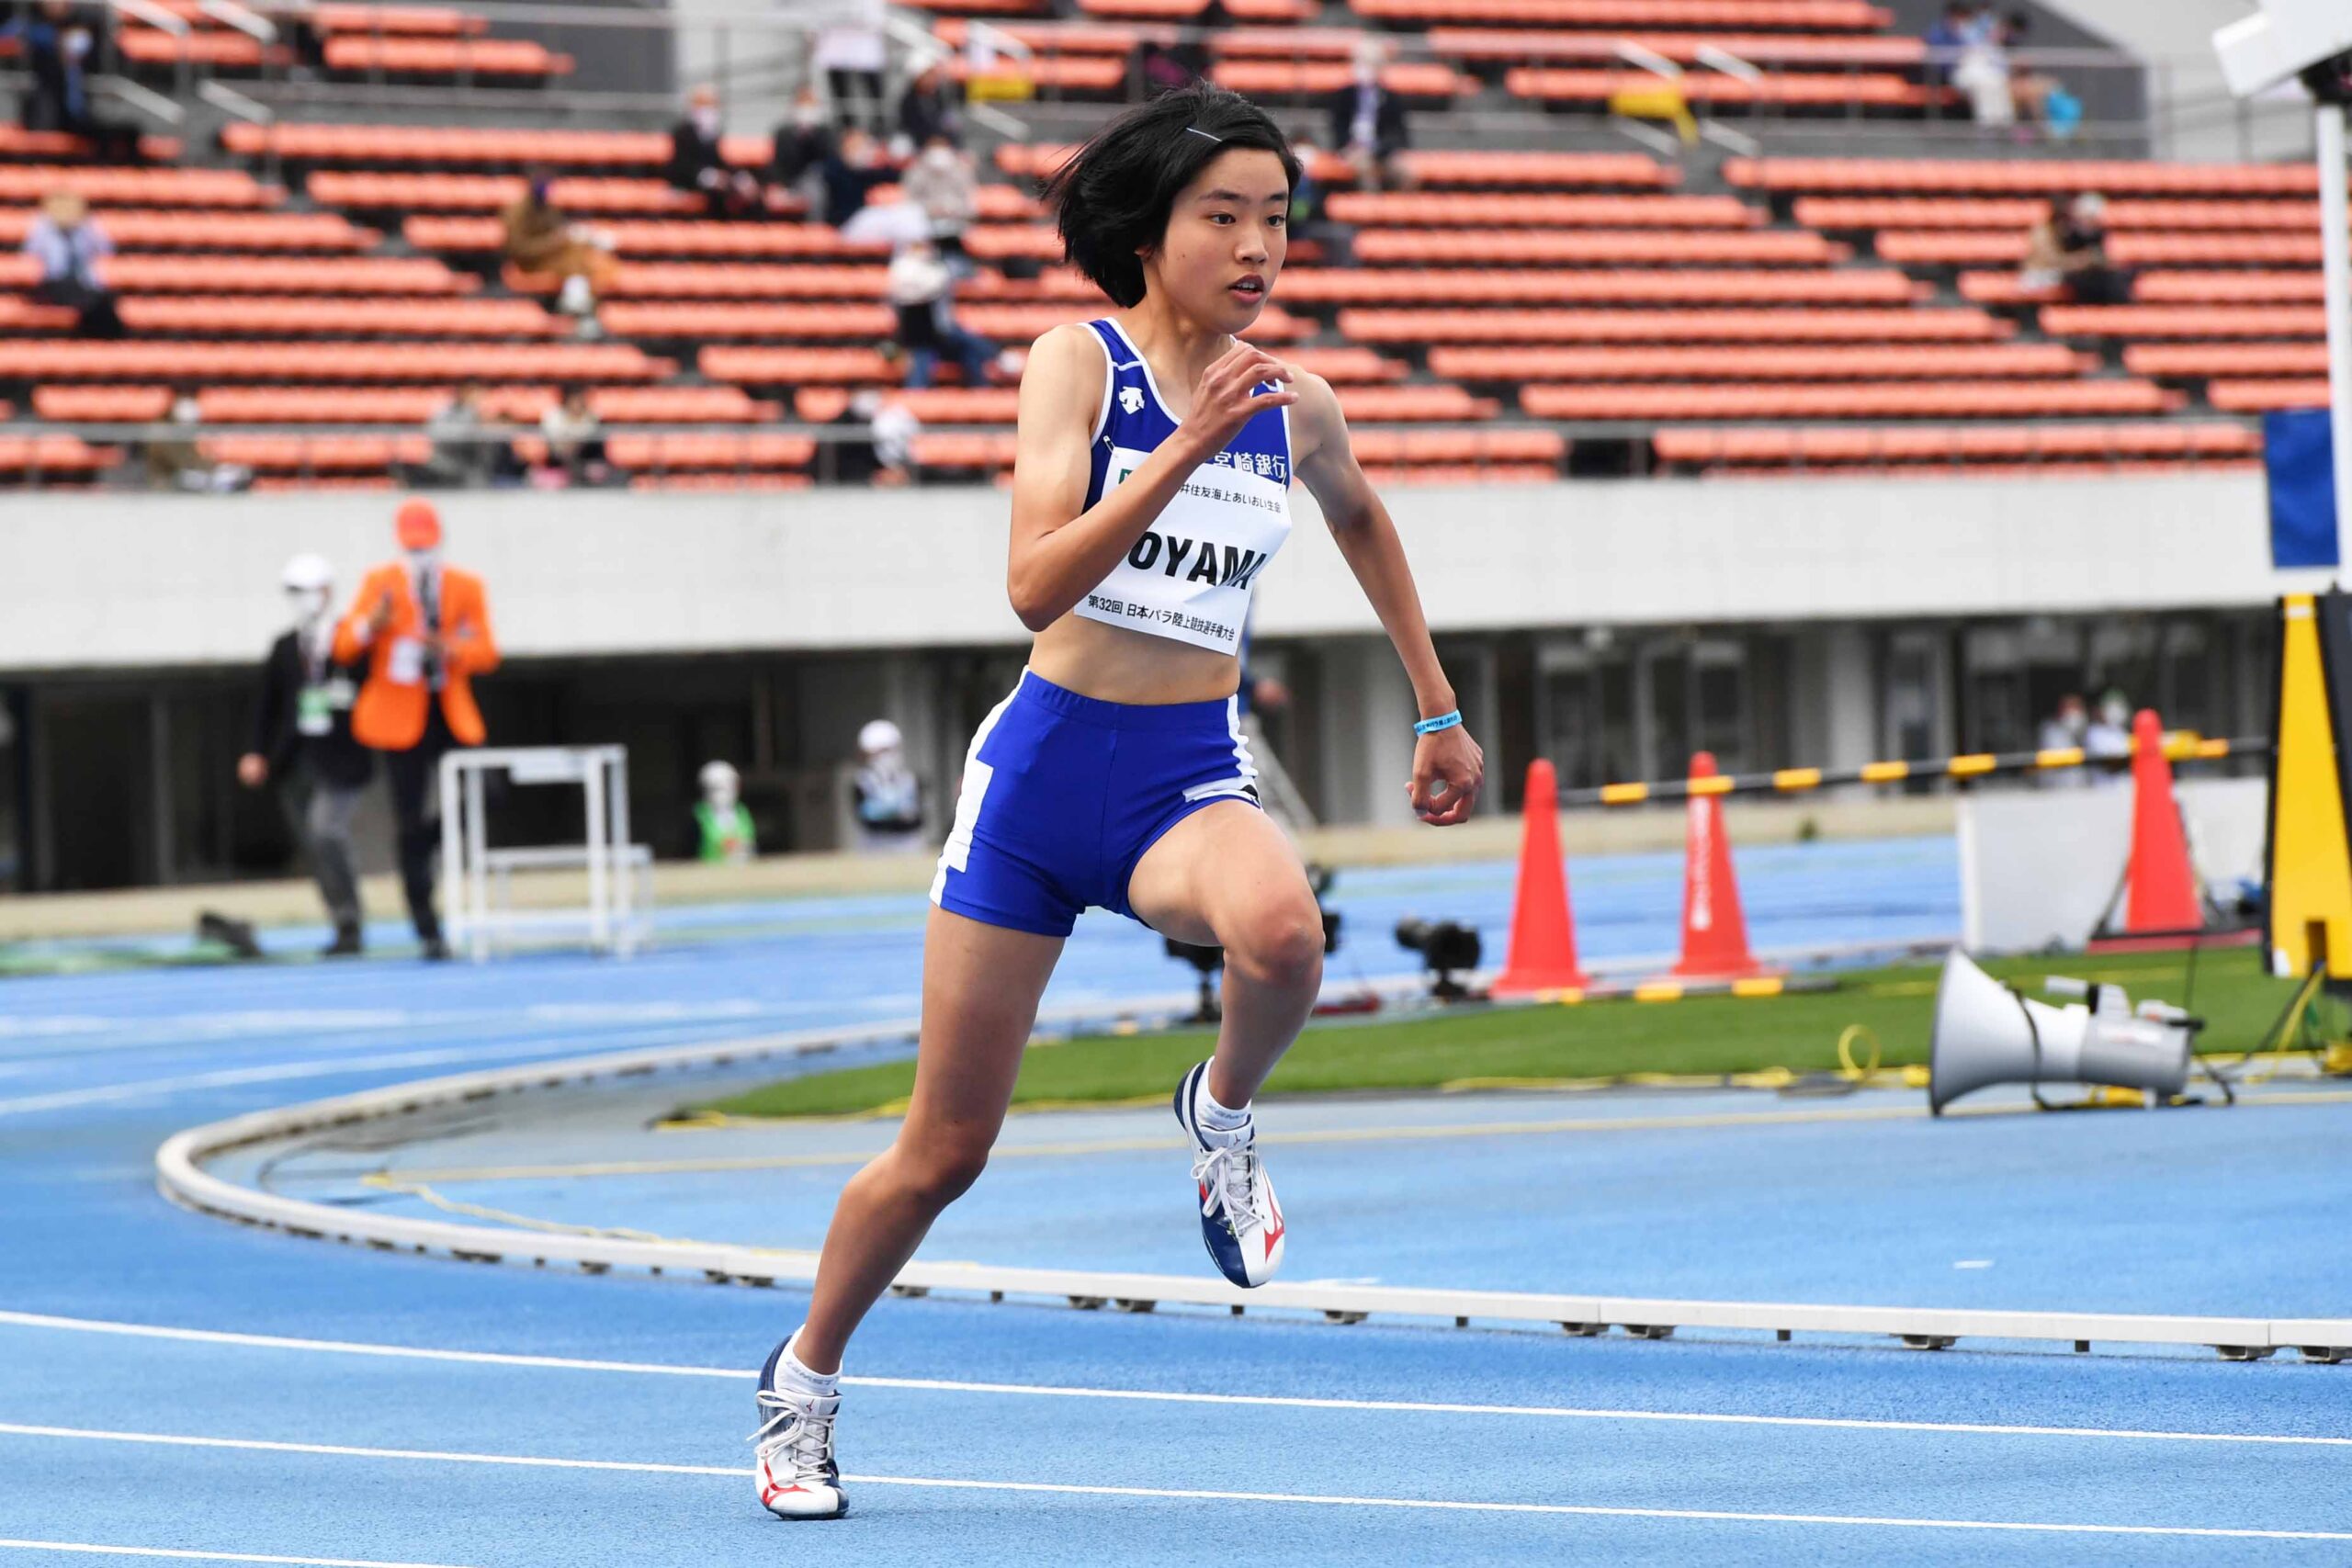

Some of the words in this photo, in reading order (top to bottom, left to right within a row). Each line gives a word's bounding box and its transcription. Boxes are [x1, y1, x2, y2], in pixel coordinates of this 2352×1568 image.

[1214, 450, 1286, 479] 宮崎銀行
[1180, 482, 1283, 513] 井住友海上あいおい生命
[1127, 531, 1267, 591] OYAMA
[1088, 594, 1124, 615] 第32回
